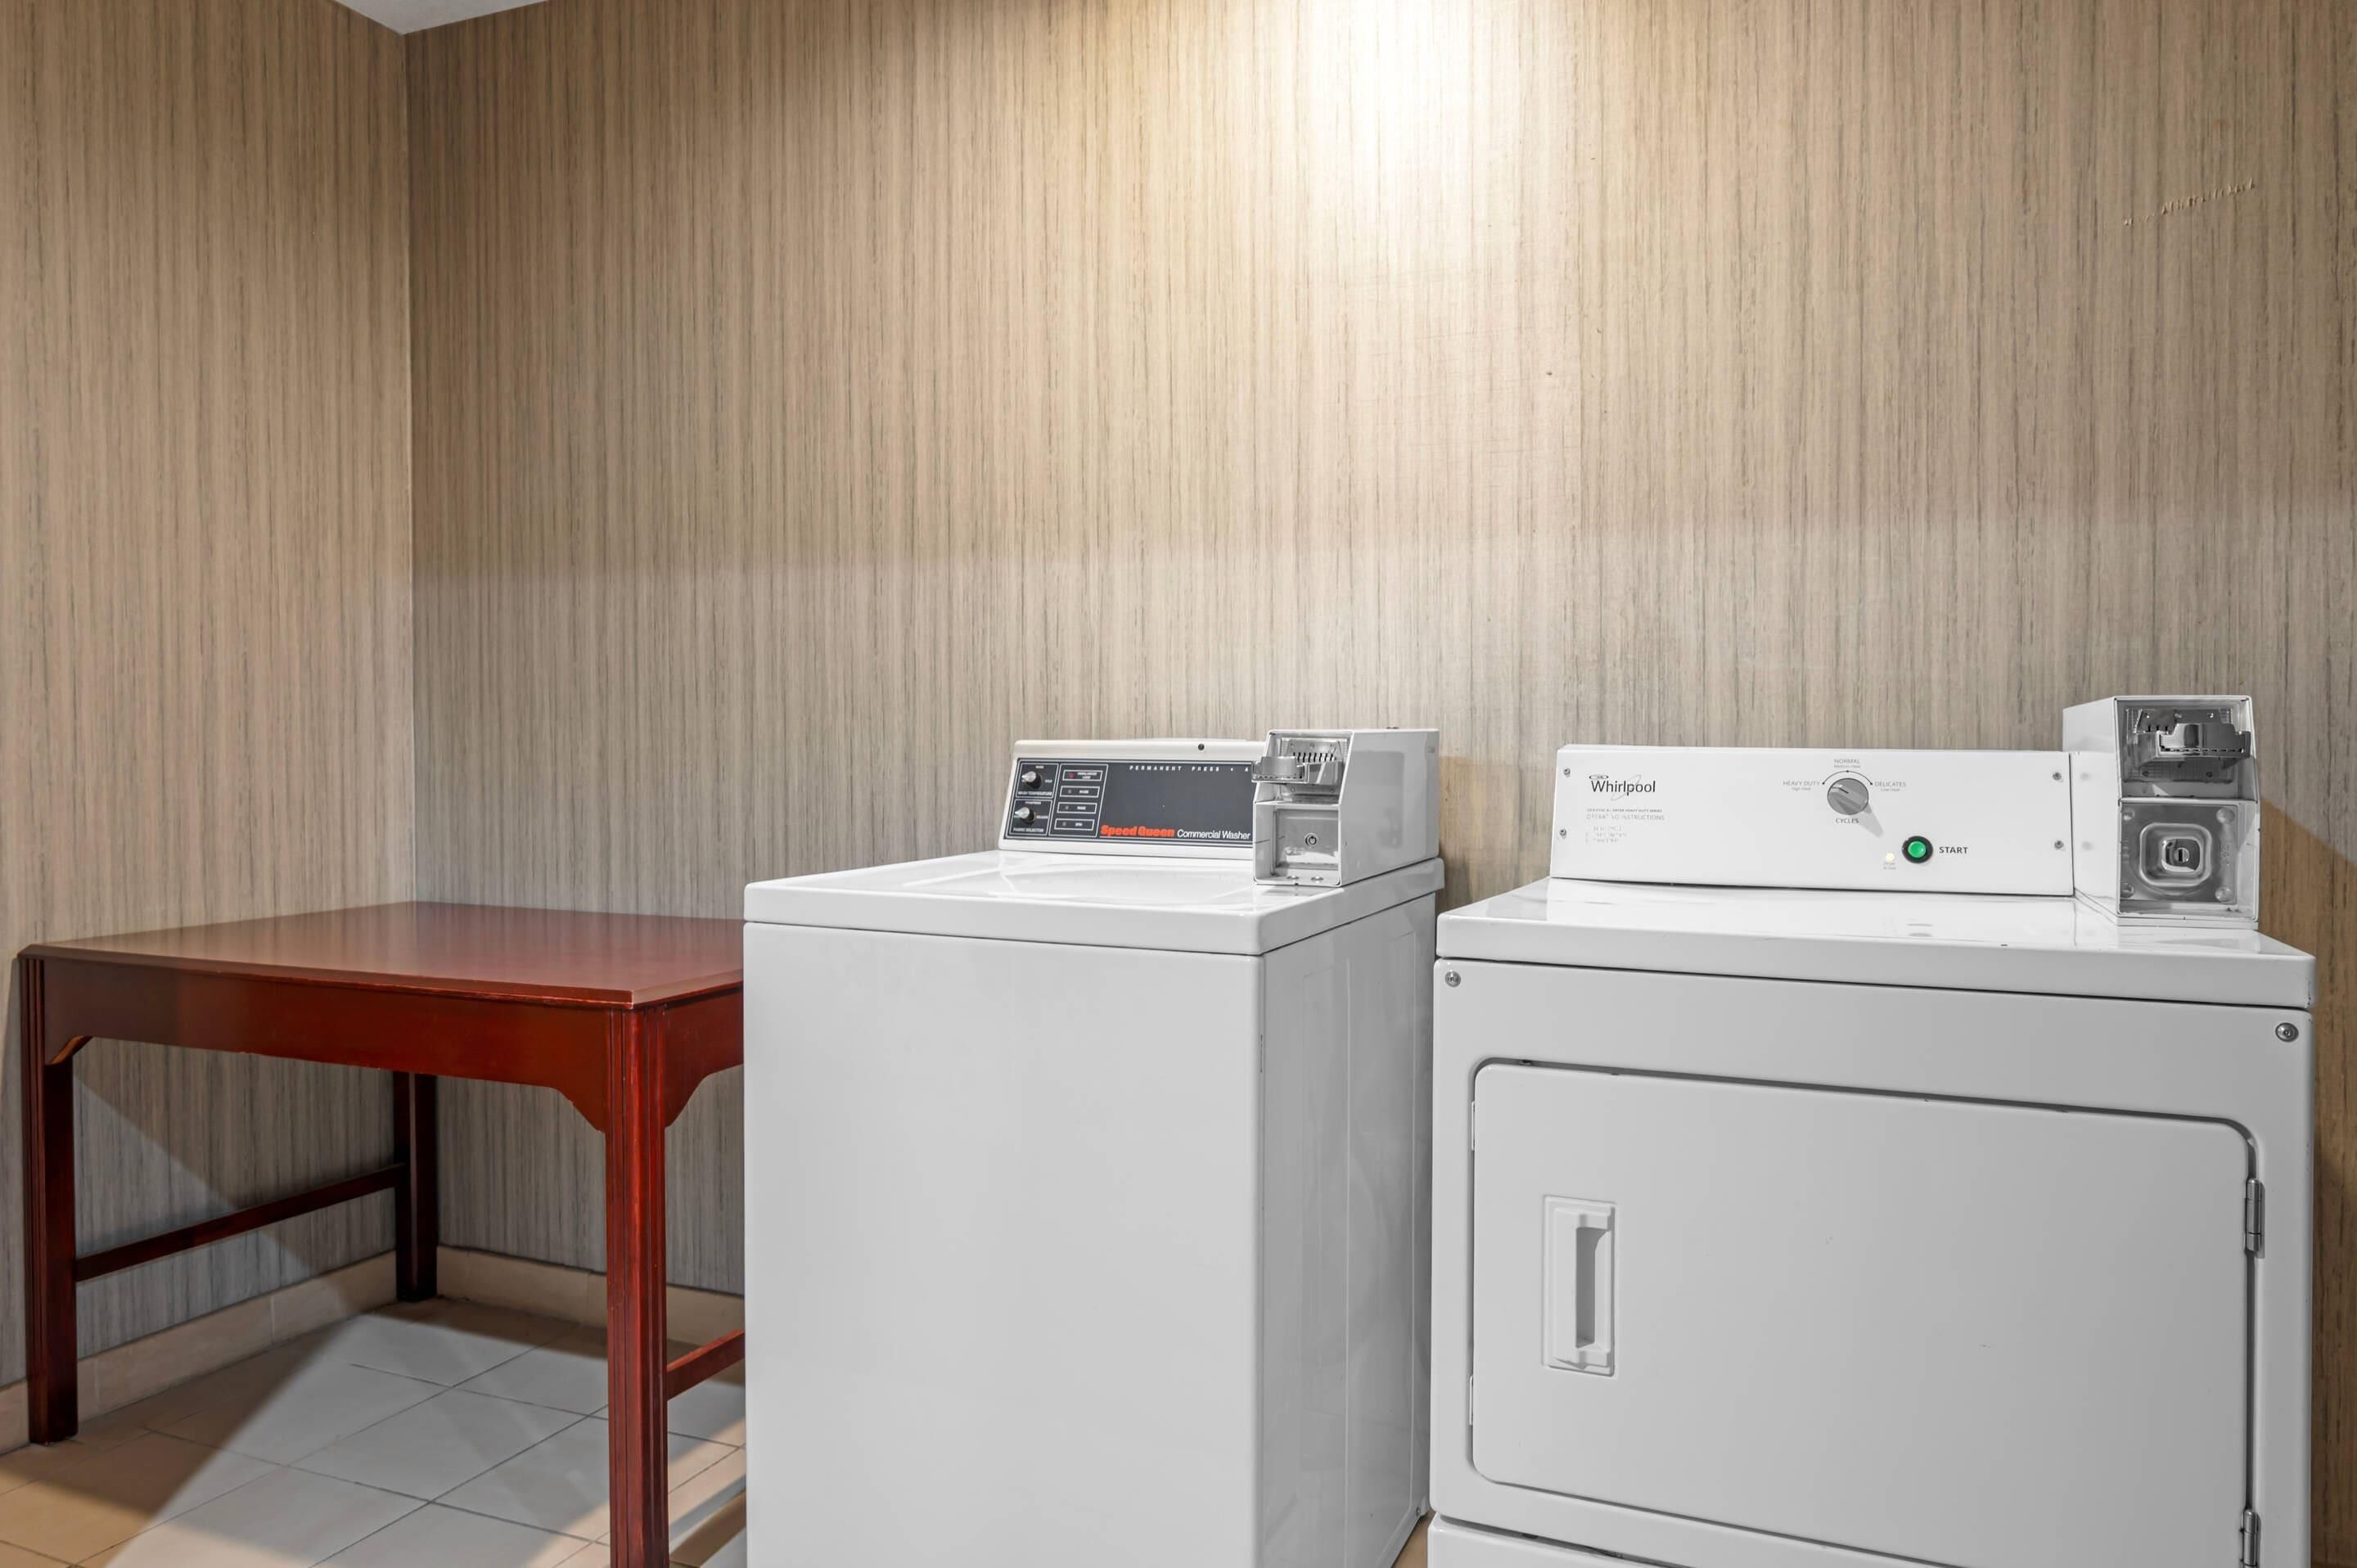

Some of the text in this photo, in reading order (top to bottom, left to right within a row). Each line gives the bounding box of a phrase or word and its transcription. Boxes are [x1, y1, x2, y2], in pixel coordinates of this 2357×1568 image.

[1591, 780, 1656, 795] Whirlpool
[1100, 824, 1251, 840] Speed Queen Commercial Washer
[1939, 846, 1969, 854] START
